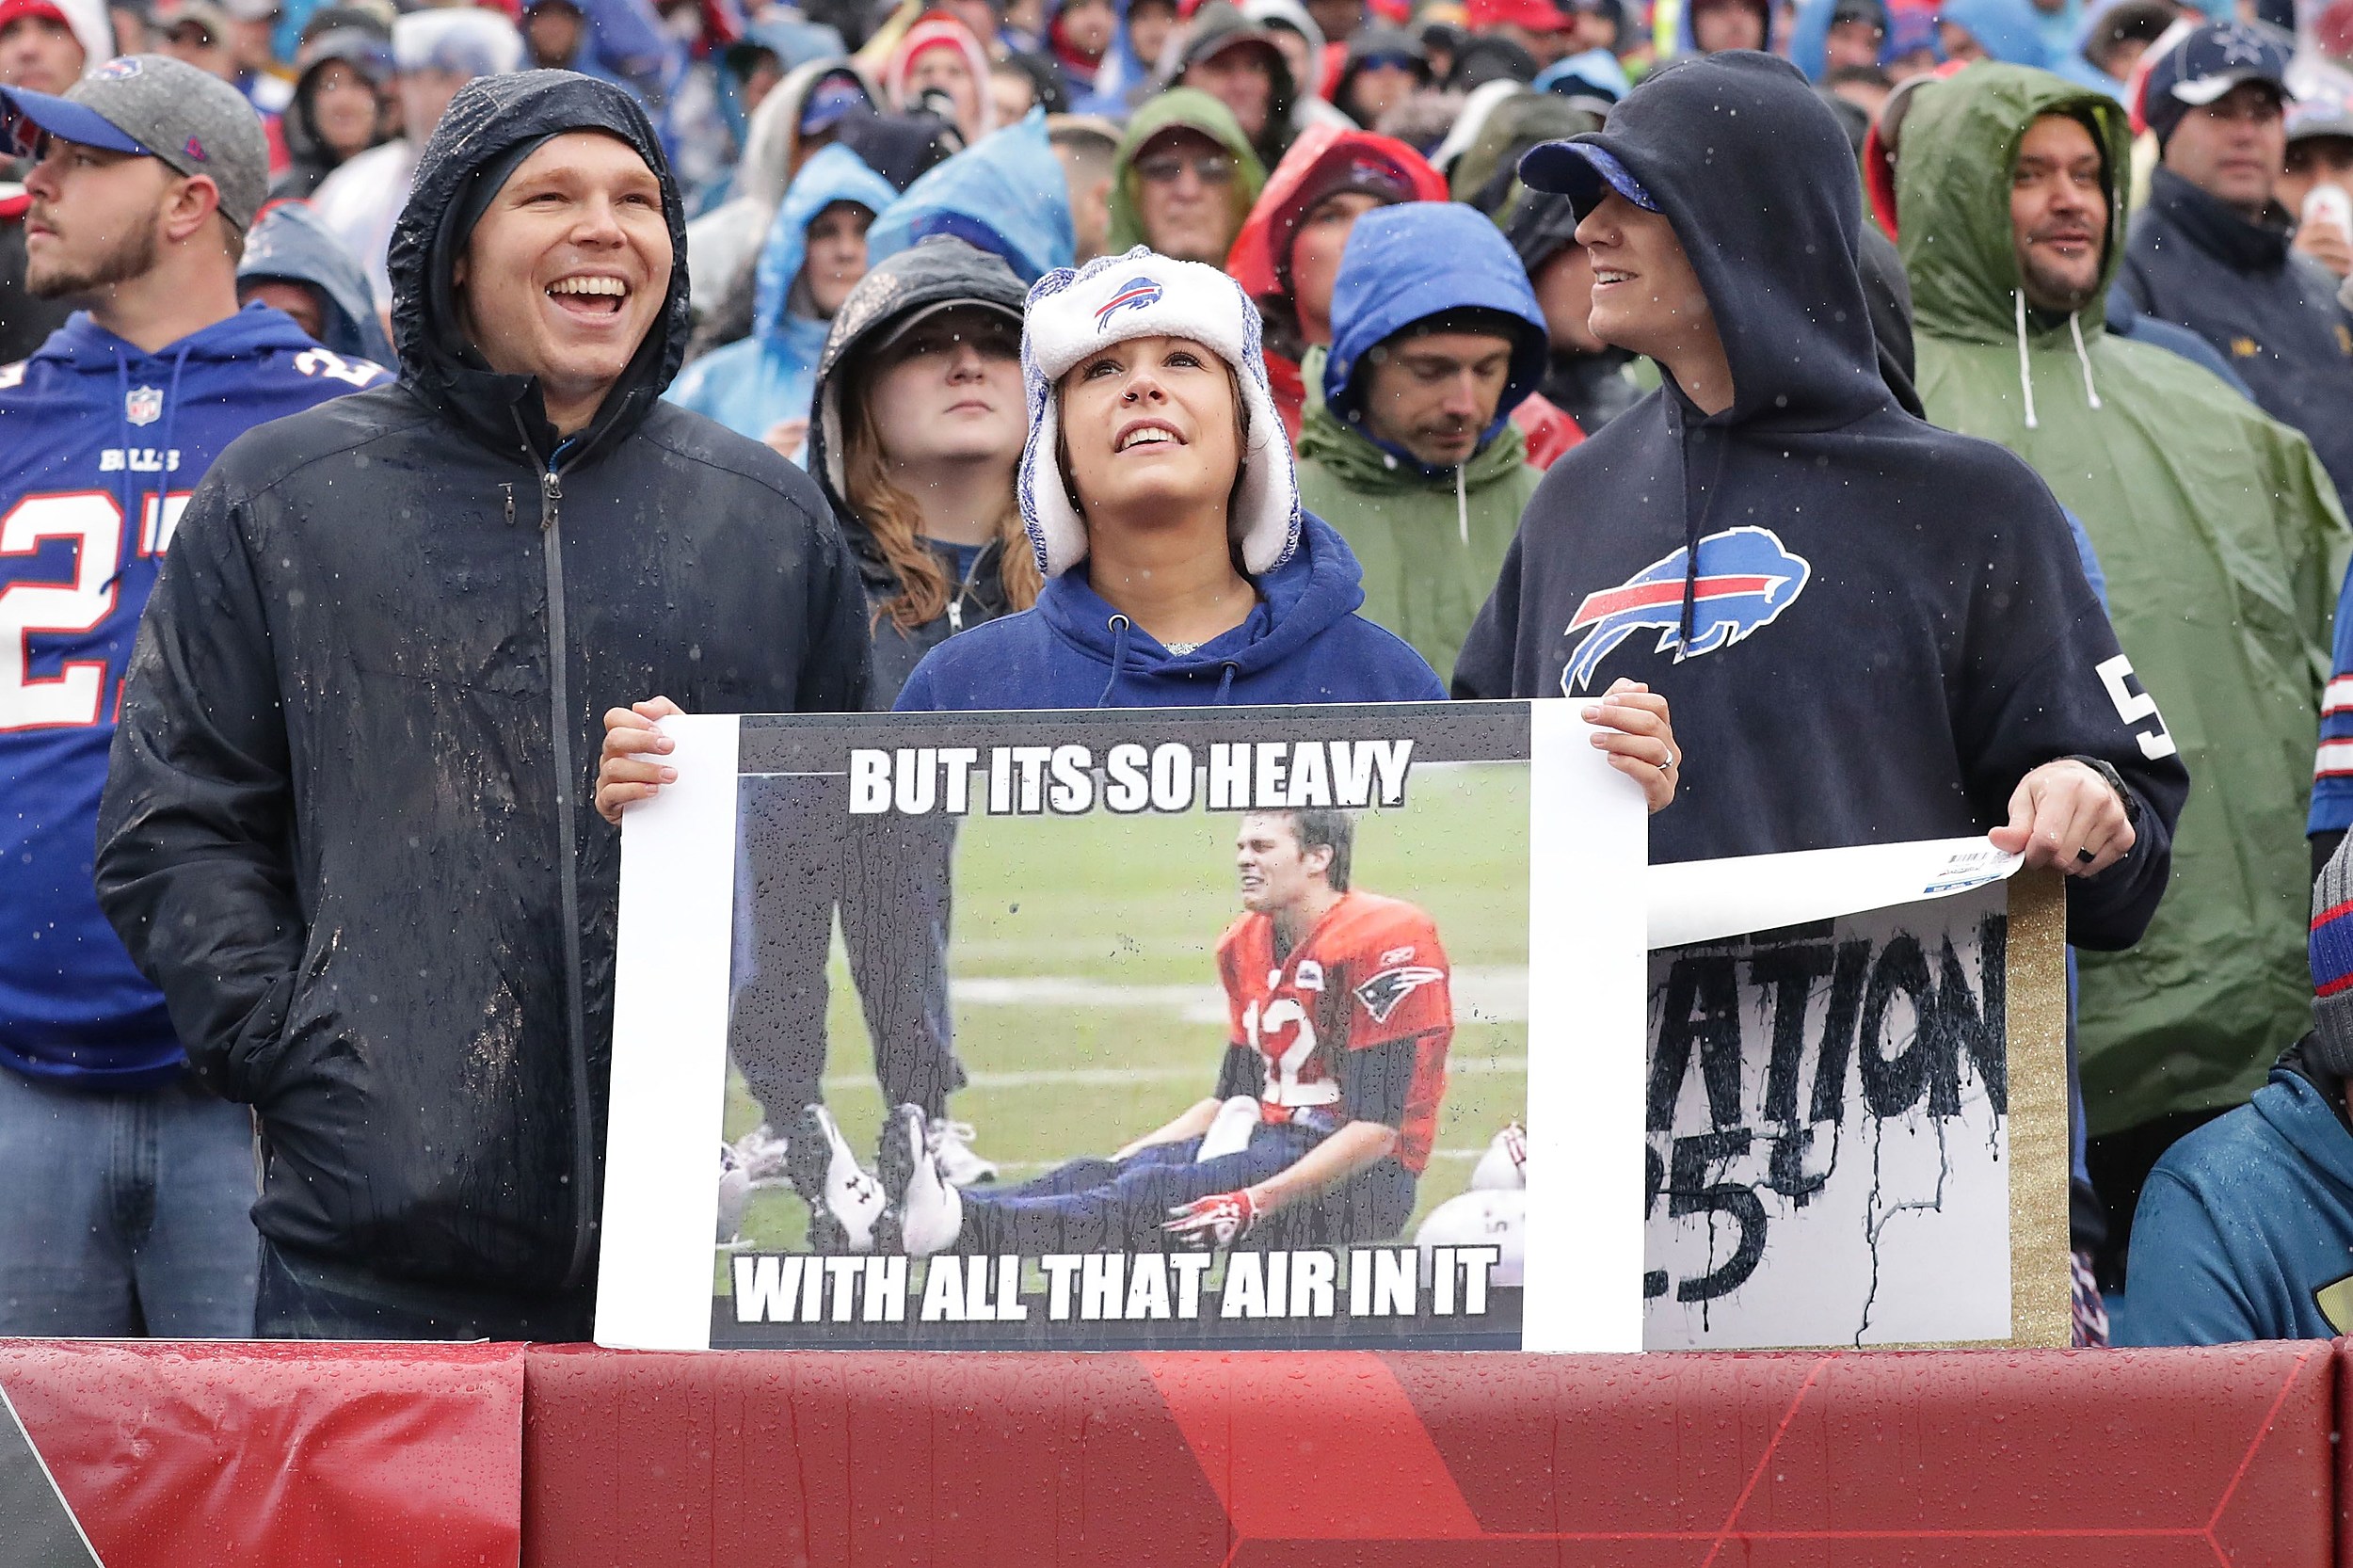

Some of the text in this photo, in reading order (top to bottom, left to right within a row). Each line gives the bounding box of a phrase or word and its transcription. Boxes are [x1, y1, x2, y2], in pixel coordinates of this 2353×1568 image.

[2095, 653, 2177, 760] 5
[848, 738, 1414, 815] BUT ITS SO HEAVY
[1242, 998, 1341, 1108] 12
[733, 1246, 1499, 1322] WITH ALL THAT AIR IN IT
